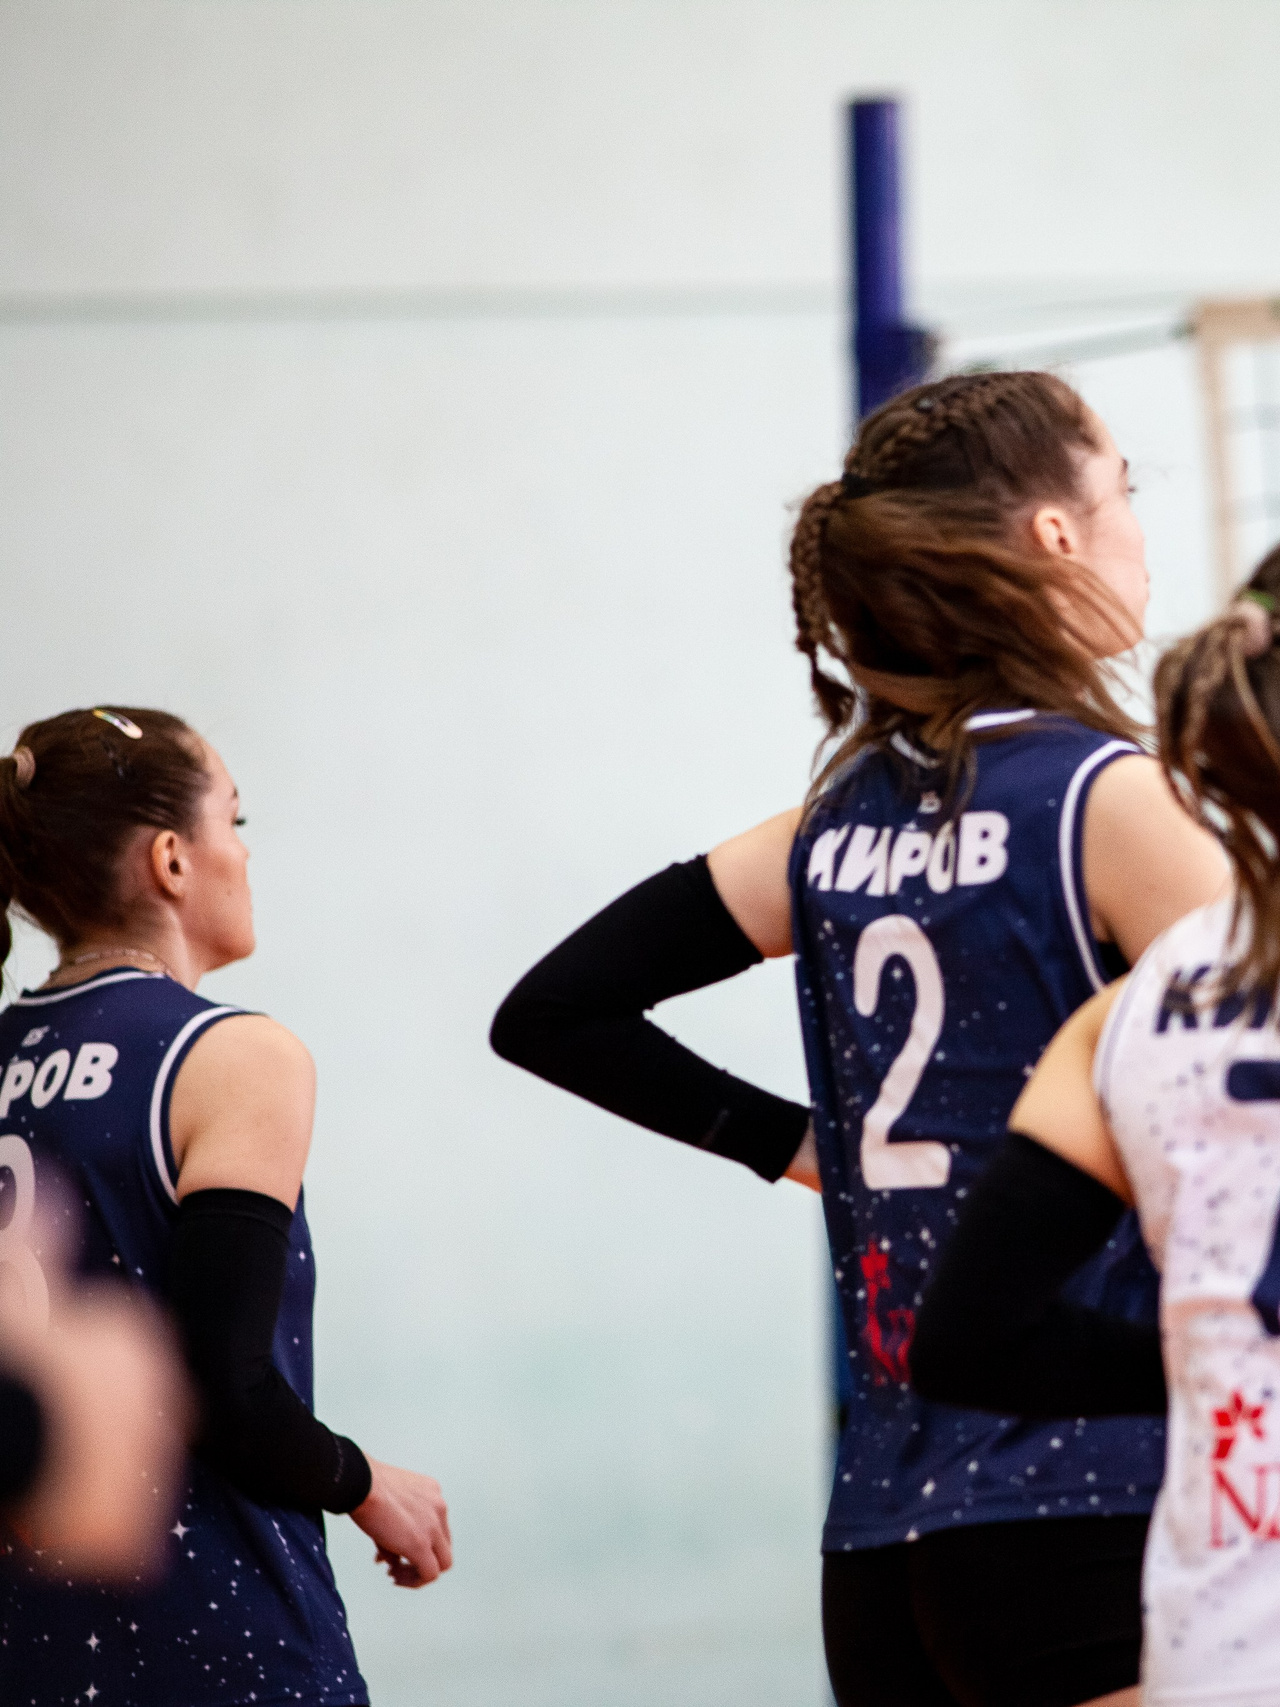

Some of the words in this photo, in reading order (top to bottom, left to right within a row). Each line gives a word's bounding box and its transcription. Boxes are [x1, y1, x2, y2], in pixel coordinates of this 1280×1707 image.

[807, 810, 1010, 897] КИРОВ
[0, 1042, 119, 1119] РОВ
[854, 914, 951, 1190] 2
